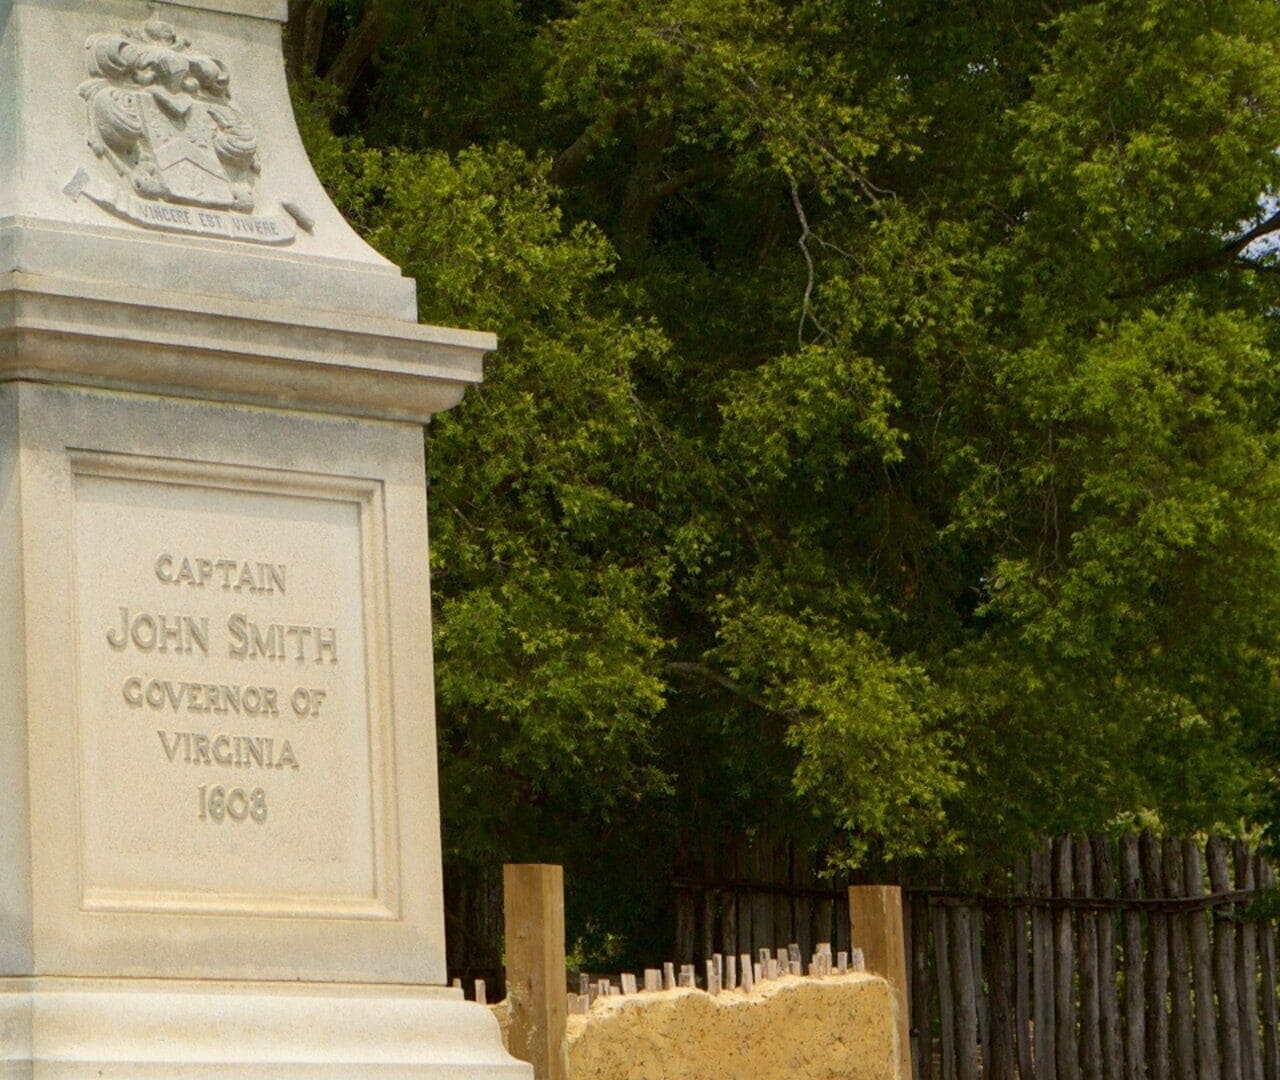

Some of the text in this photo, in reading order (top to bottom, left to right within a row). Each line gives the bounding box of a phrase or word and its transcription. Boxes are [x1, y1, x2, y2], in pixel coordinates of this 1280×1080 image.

[198, 212, 223, 229] EST
[155, 553, 287, 594] CAPTAIN
[106, 607, 338, 665] JOHN SMITH
[122, 677, 326, 718] GOVERNOR OF
[157, 730, 300, 770] VIRGINIA
[198, 784, 268, 823] 1608
